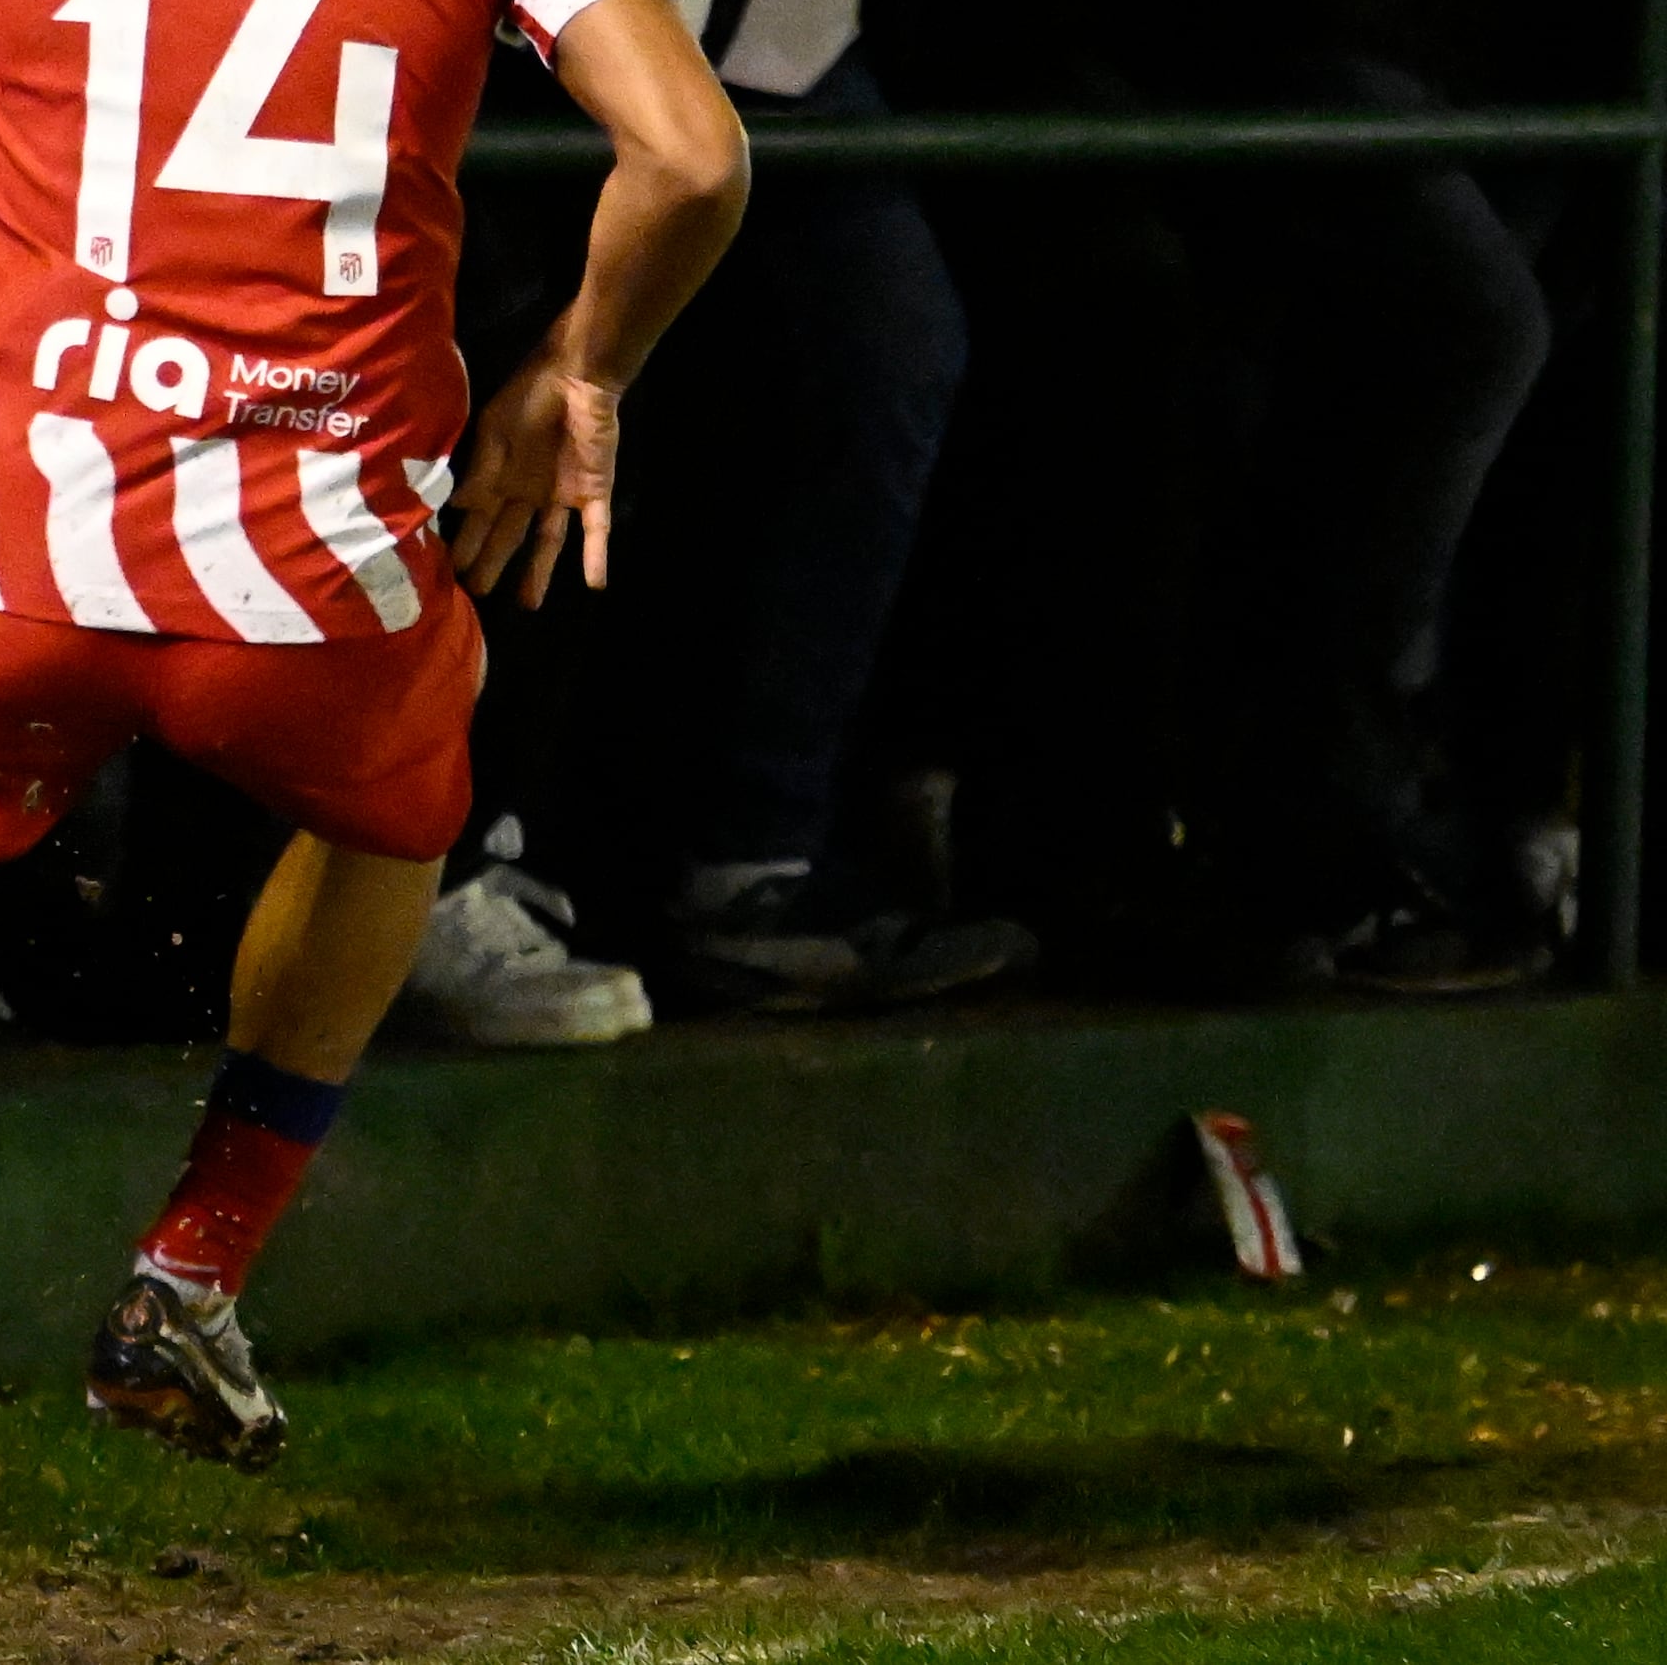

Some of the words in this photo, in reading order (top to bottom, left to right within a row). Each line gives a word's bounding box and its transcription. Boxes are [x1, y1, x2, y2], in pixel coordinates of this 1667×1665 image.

[33, 287, 211, 419] ria
[230, 354, 361, 403] Money
[223, 390, 370, 438] Transfer
